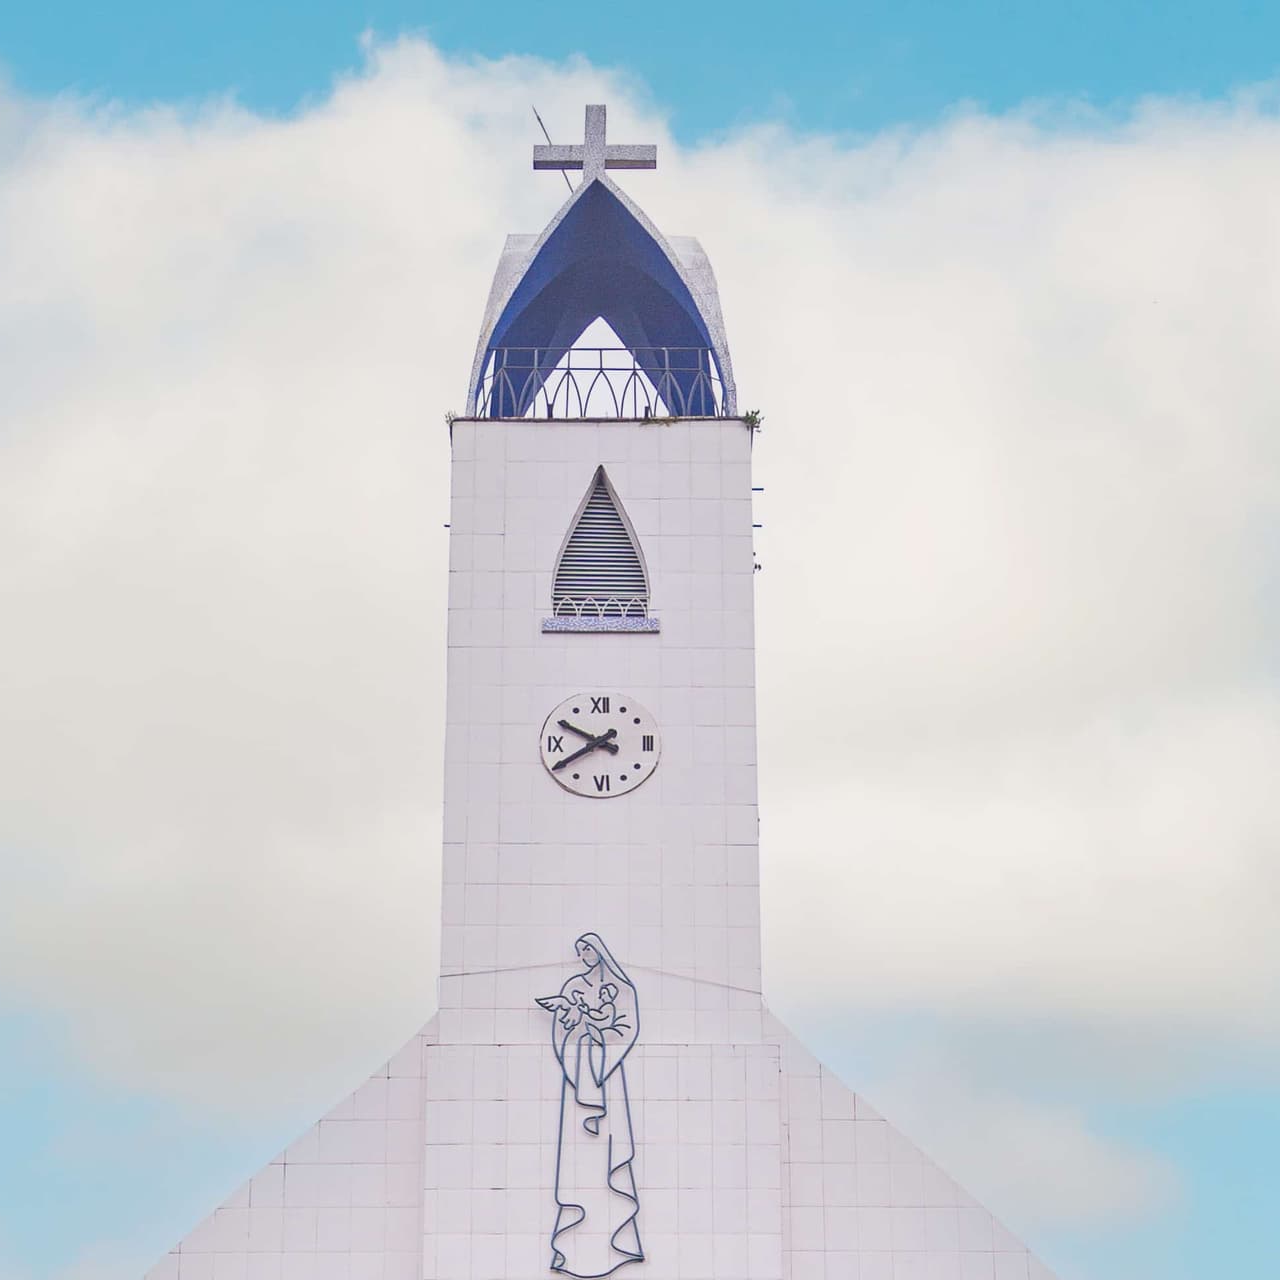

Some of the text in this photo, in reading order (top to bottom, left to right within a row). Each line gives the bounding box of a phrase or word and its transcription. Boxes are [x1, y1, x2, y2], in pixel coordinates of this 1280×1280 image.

[591, 697, 609, 713] XII
[548, 736, 563, 752] IX
[643, 735, 653, 751] III
[593, 775, 610, 791] VI
